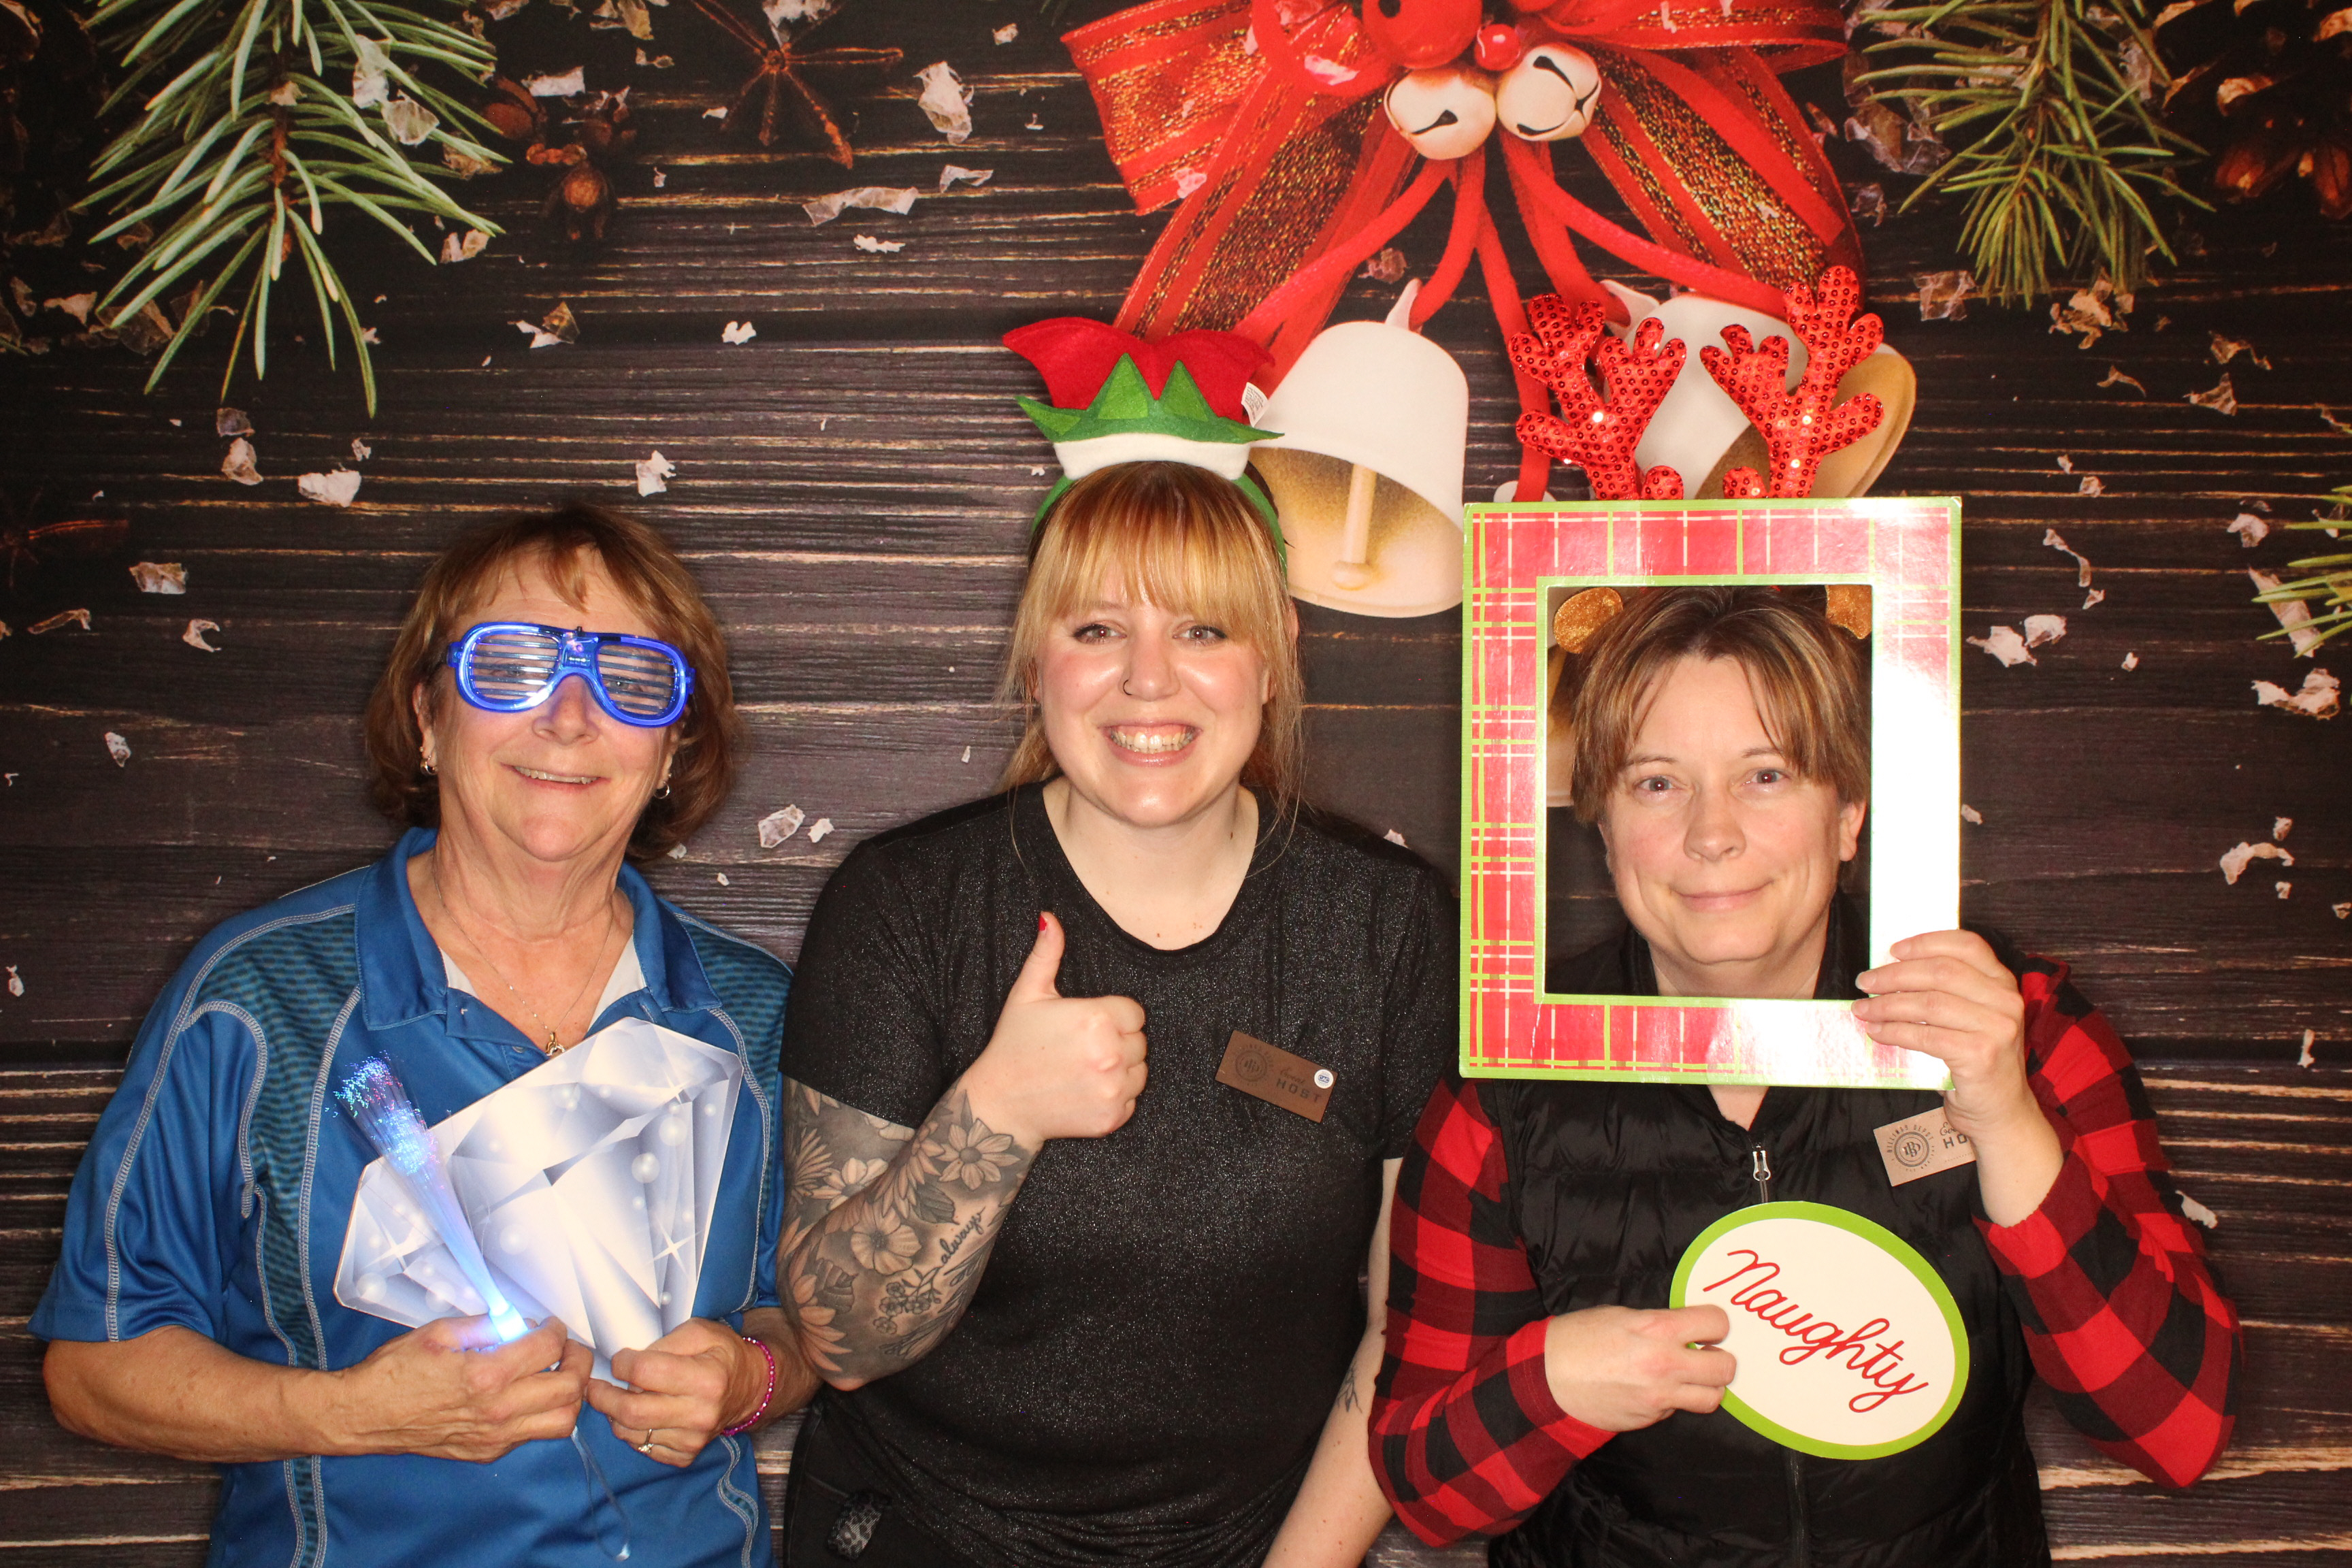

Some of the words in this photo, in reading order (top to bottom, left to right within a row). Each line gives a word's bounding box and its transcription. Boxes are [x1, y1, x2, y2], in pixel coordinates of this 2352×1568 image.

[1276, 1078, 1322, 1103] HOST
[1943, 1133, 1967, 1149] HO
[939, 1205, 986, 1264] always
[1703, 1250, 1929, 1413] Naughty
